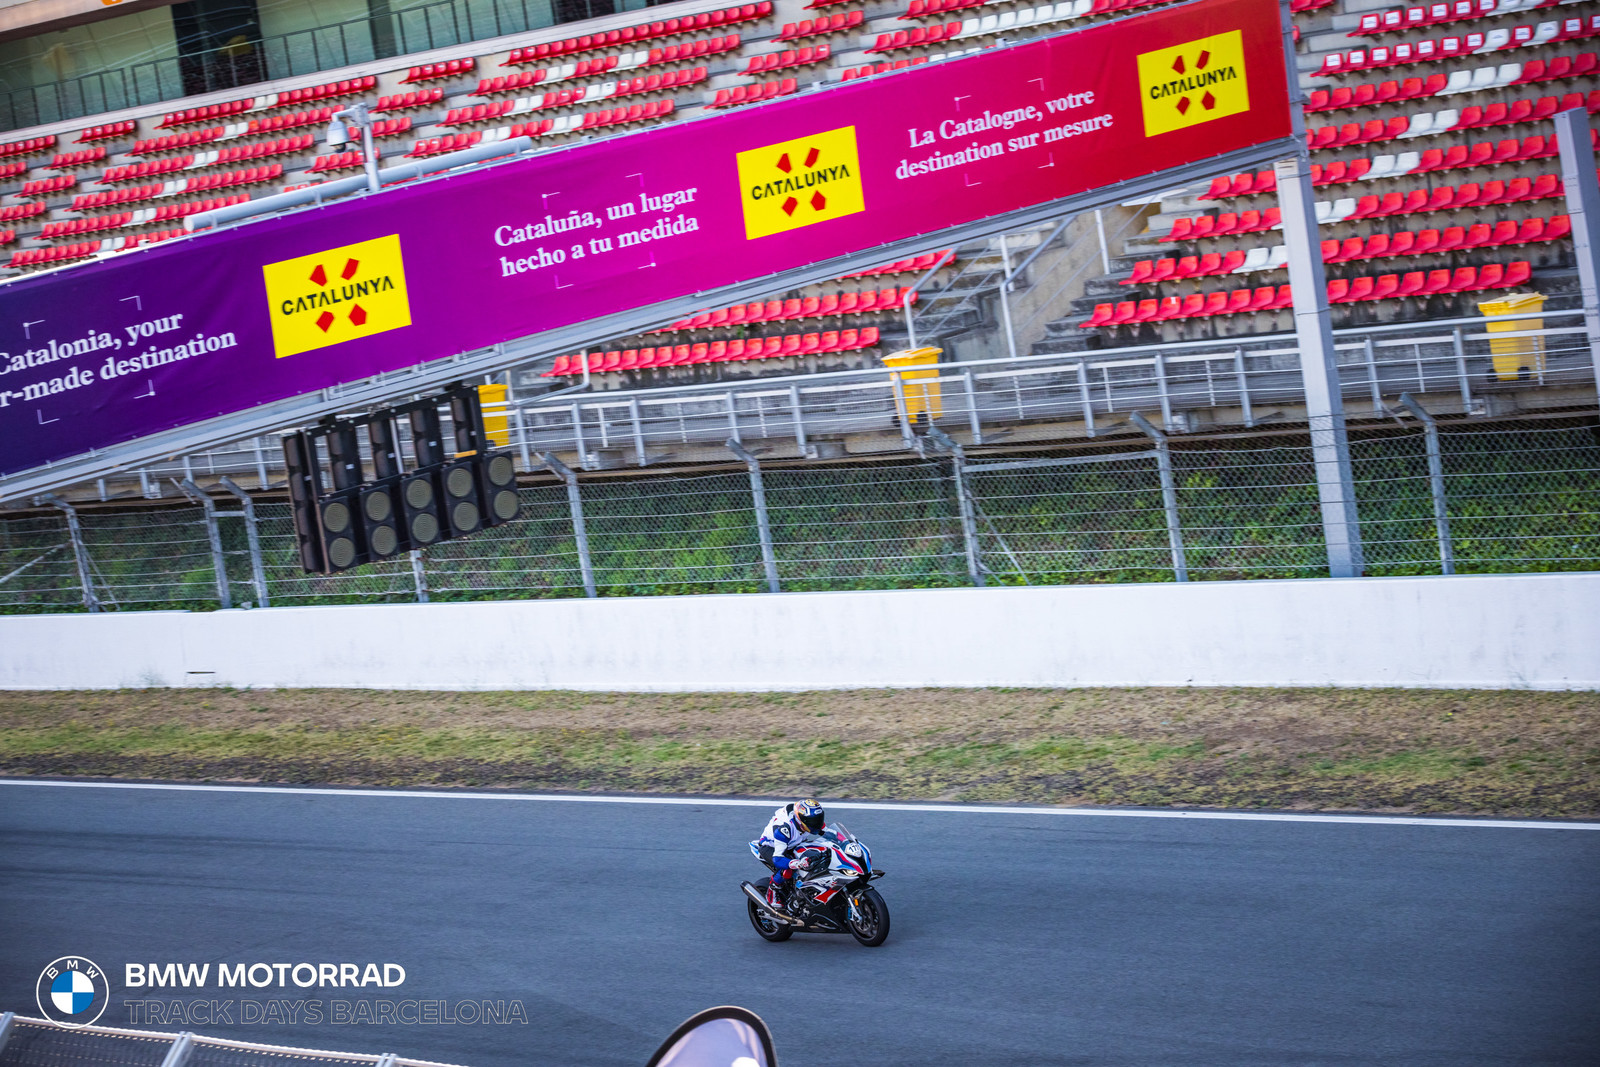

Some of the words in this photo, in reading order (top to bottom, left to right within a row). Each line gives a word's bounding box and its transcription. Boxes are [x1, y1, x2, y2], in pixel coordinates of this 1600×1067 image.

[1150, 66, 1237, 100] CATALUNYA
[909, 126, 936, 148] La
[939, 99, 1044, 140] Catalogne,
[1045, 90, 1095, 115] votre
[895, 141, 1005, 180] destination
[1007, 133, 1041, 153] sur
[1043, 113, 1114, 144] mesure
[751, 164, 850, 200] CATALUNYA
[494, 208, 602, 247] Cataluña,
[606, 200, 637, 221] un
[640, 187, 698, 214] lugar
[500, 249, 566, 277] hecho
[570, 242, 586, 259] a
[589, 233, 614, 254] tu
[618, 213, 700, 247] medida
[281, 275, 395, 316] CATALUNYA
[127, 313, 184, 348] your
[99, 331, 238, 381] destination
